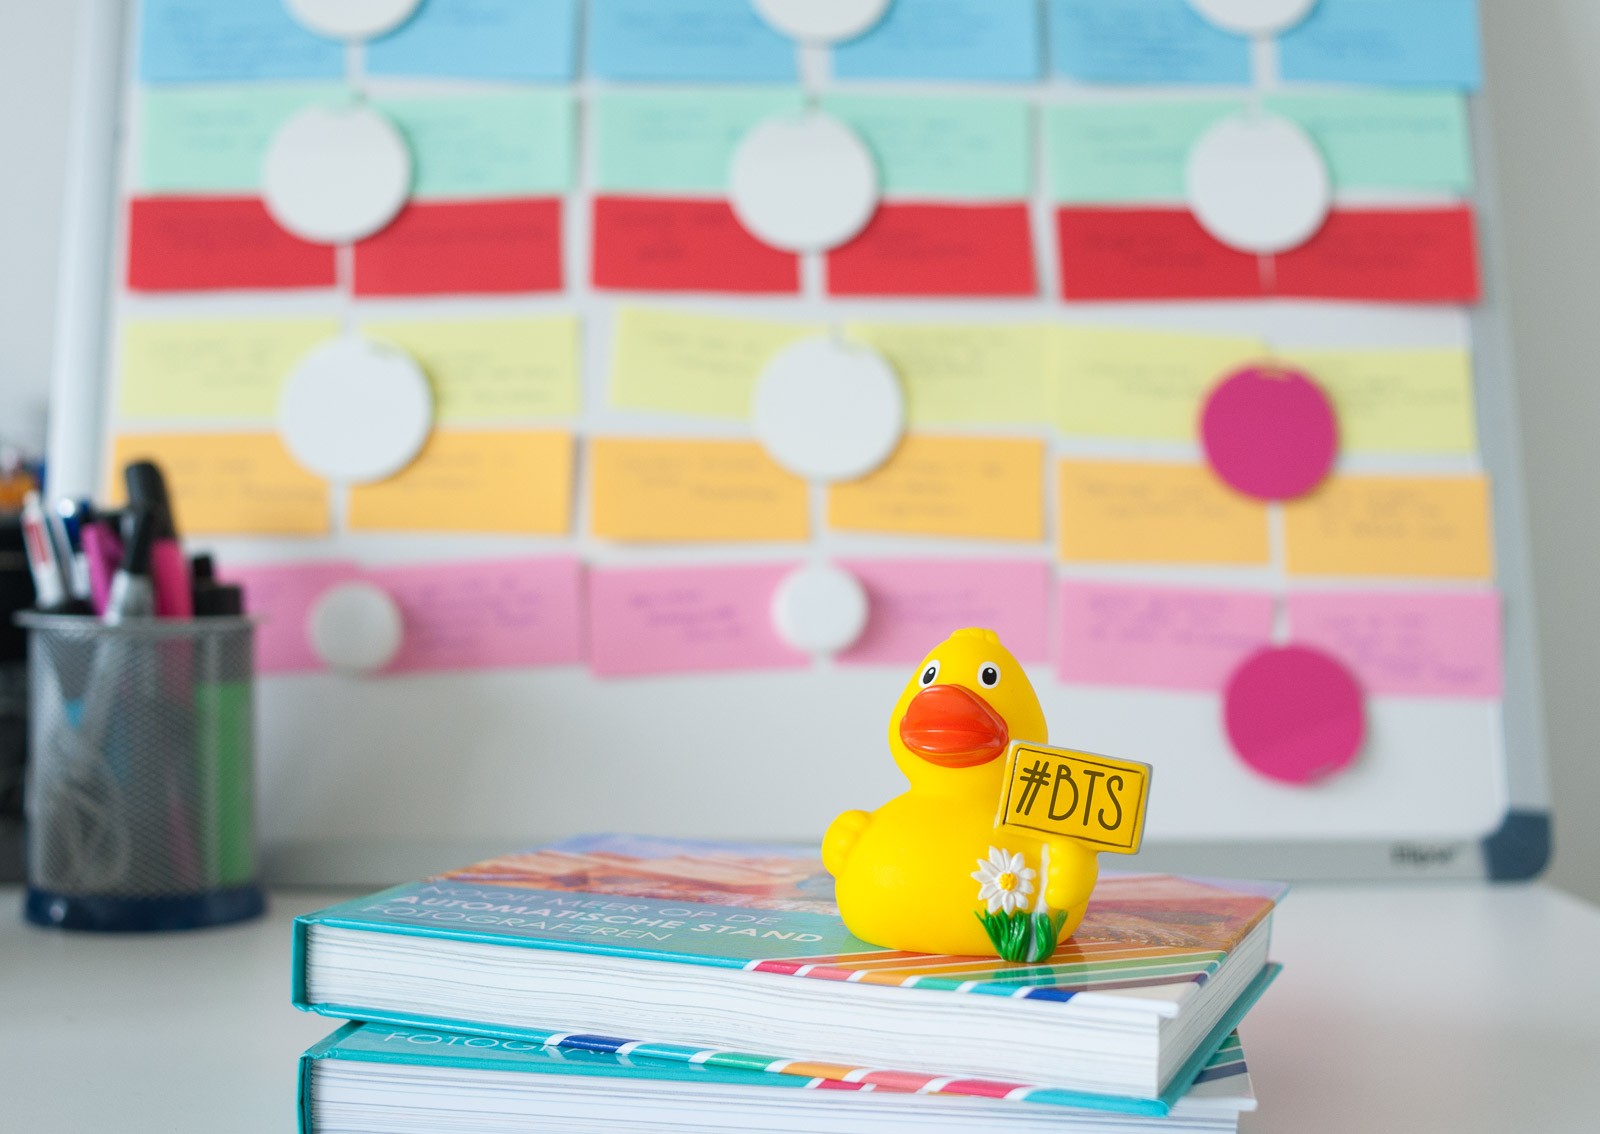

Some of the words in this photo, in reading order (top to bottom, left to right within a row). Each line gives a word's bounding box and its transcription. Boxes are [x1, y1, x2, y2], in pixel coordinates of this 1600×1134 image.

[1015, 760, 1123, 831] #BTS
[361, 904, 673, 942] FOTOGRAFEREN
[390, 895, 686, 929] AUTOMATISCHE
[690, 923, 823, 943] STAND
[419, 885, 545, 902] NOOIT
[543, 897, 649, 913] MEER
[658, 908, 718, 919] OP
[724, 914, 783, 926] DE
